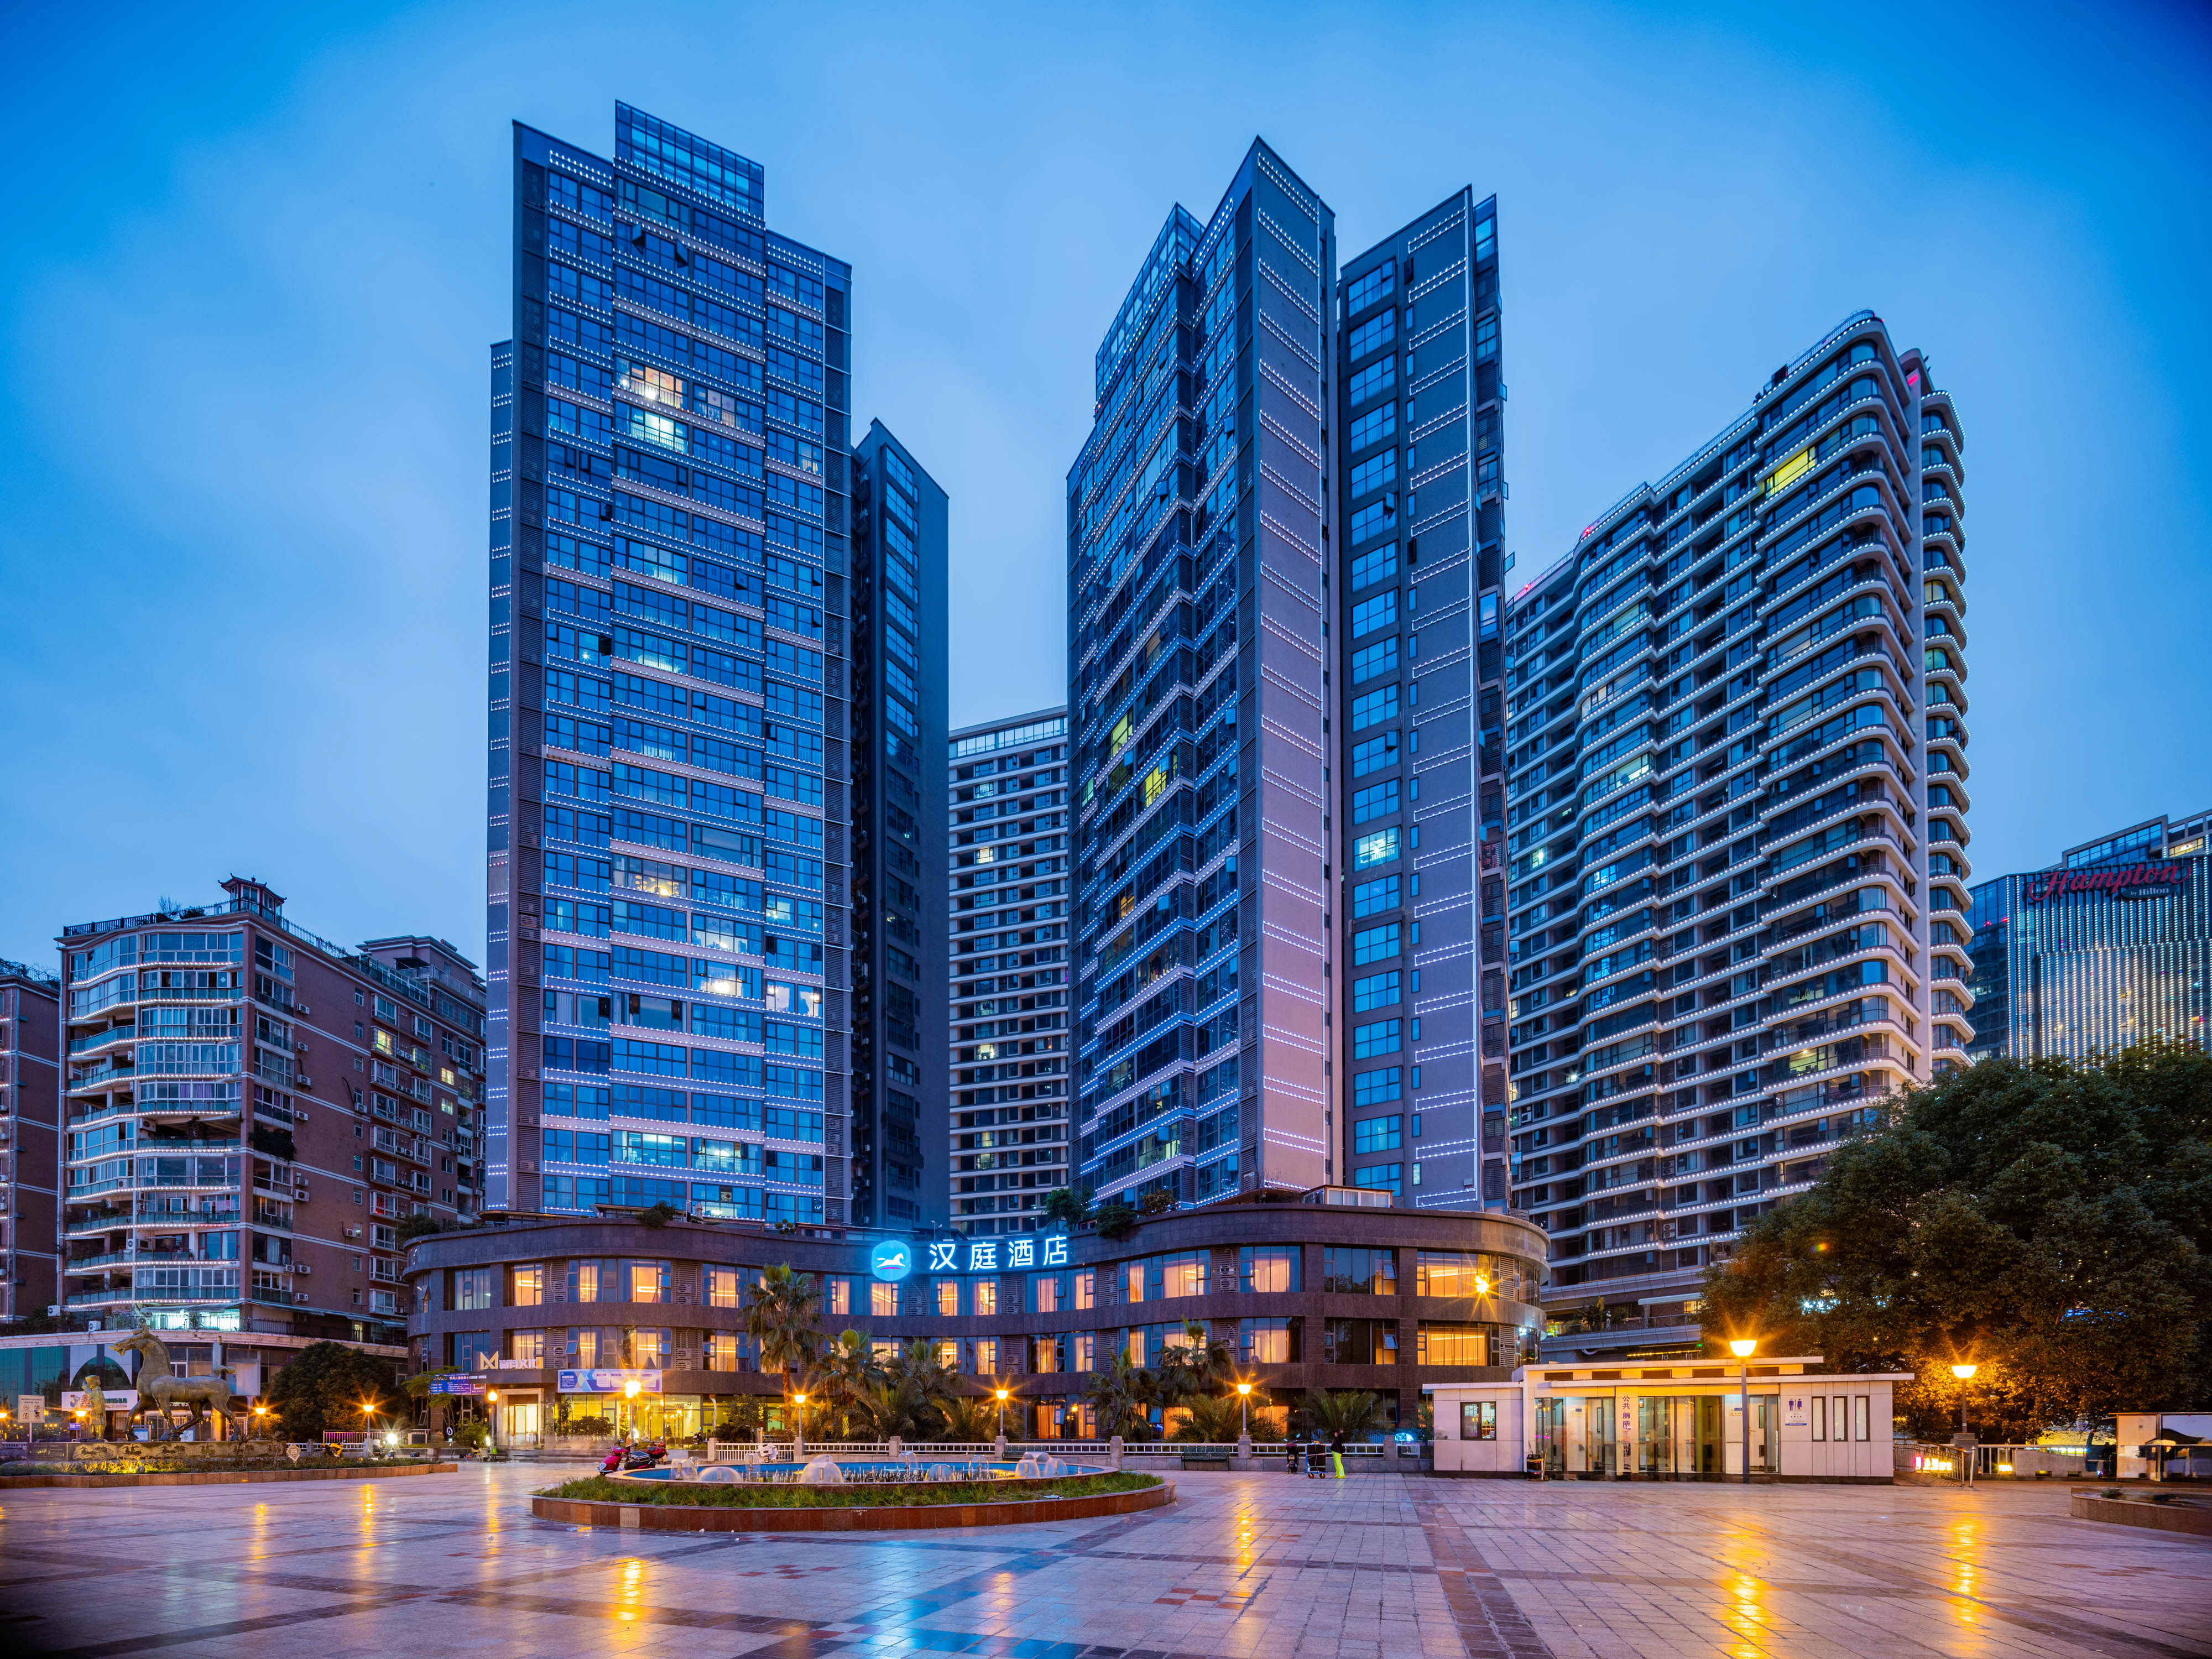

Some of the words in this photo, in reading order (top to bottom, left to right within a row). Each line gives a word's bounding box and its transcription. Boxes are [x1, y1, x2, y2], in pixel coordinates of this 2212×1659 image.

[2028, 864, 2192, 901] Hampton
[2139, 887, 2169, 896] Hilton
[929, 1235, 1068, 1271] 汉庭酒店
